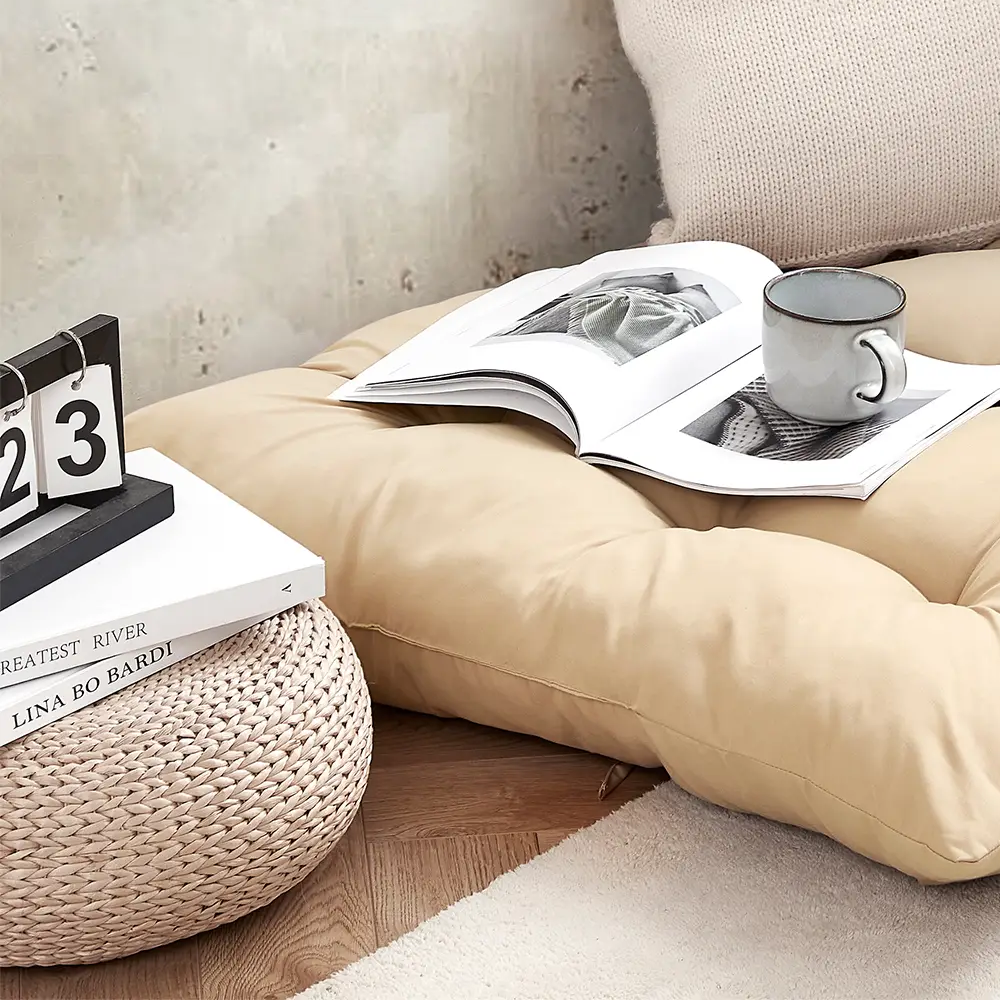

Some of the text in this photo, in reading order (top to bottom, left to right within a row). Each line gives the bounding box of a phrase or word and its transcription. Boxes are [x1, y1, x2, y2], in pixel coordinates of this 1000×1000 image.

[0, 399, 106, 512] 2 3
[0, 622, 148, 675] REATEST RIVER
[12, 640, 173, 730] LINA BO BARDI
